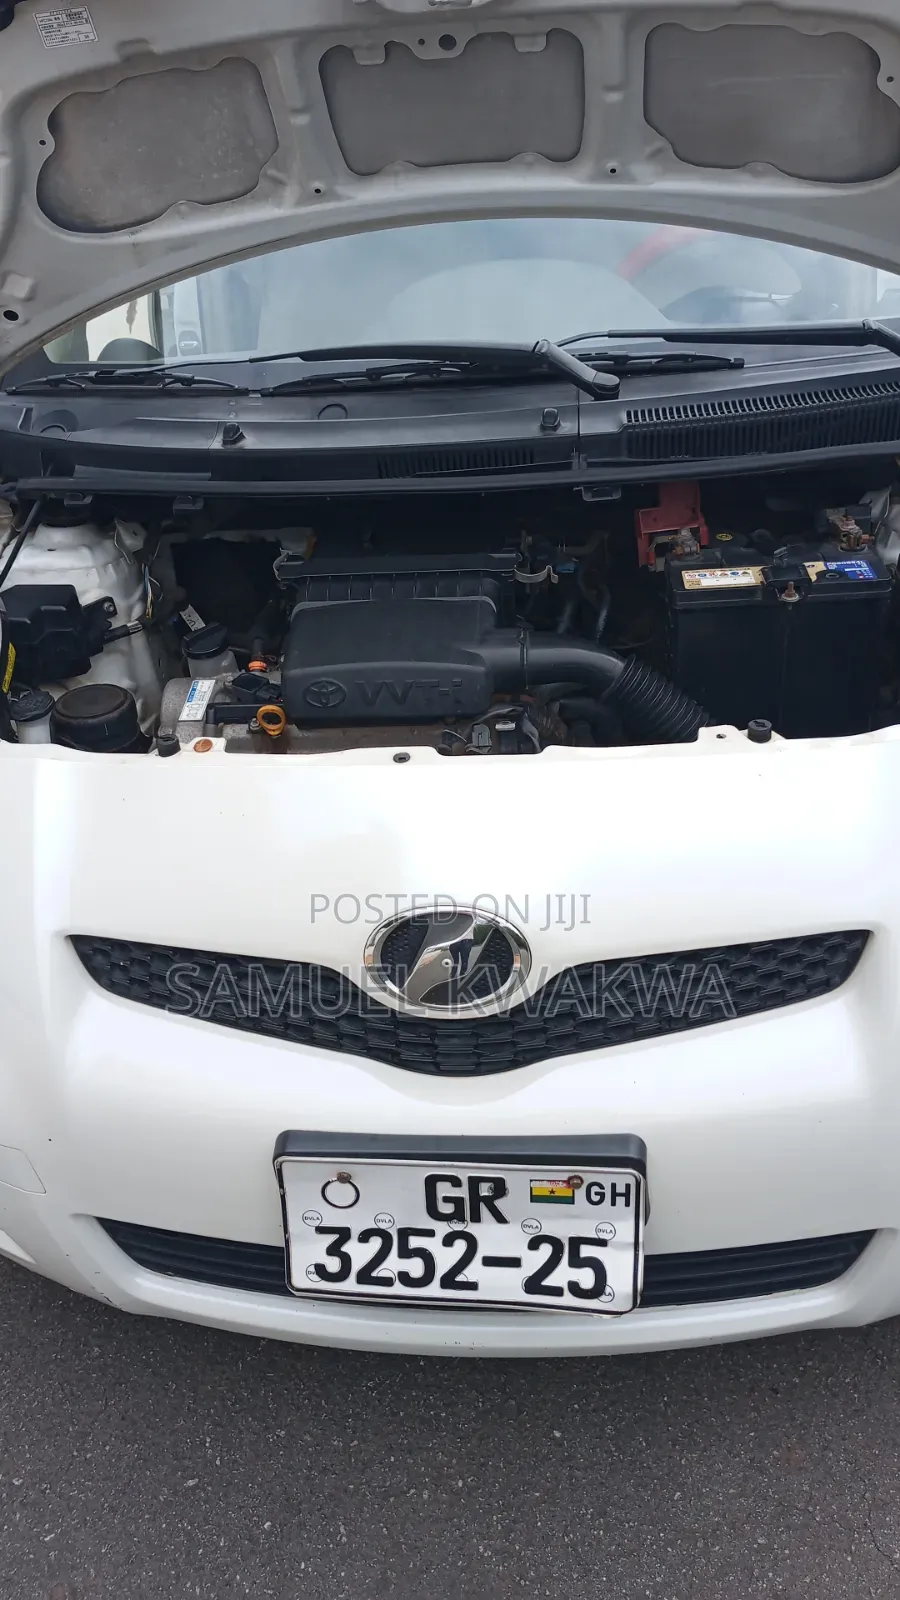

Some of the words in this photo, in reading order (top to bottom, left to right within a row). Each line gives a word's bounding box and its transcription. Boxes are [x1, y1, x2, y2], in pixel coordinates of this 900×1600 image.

[424, 1173, 510, 1224] GR
[585, 1181, 631, 1207] GH
[314, 1226, 608, 1299] 3252-25
